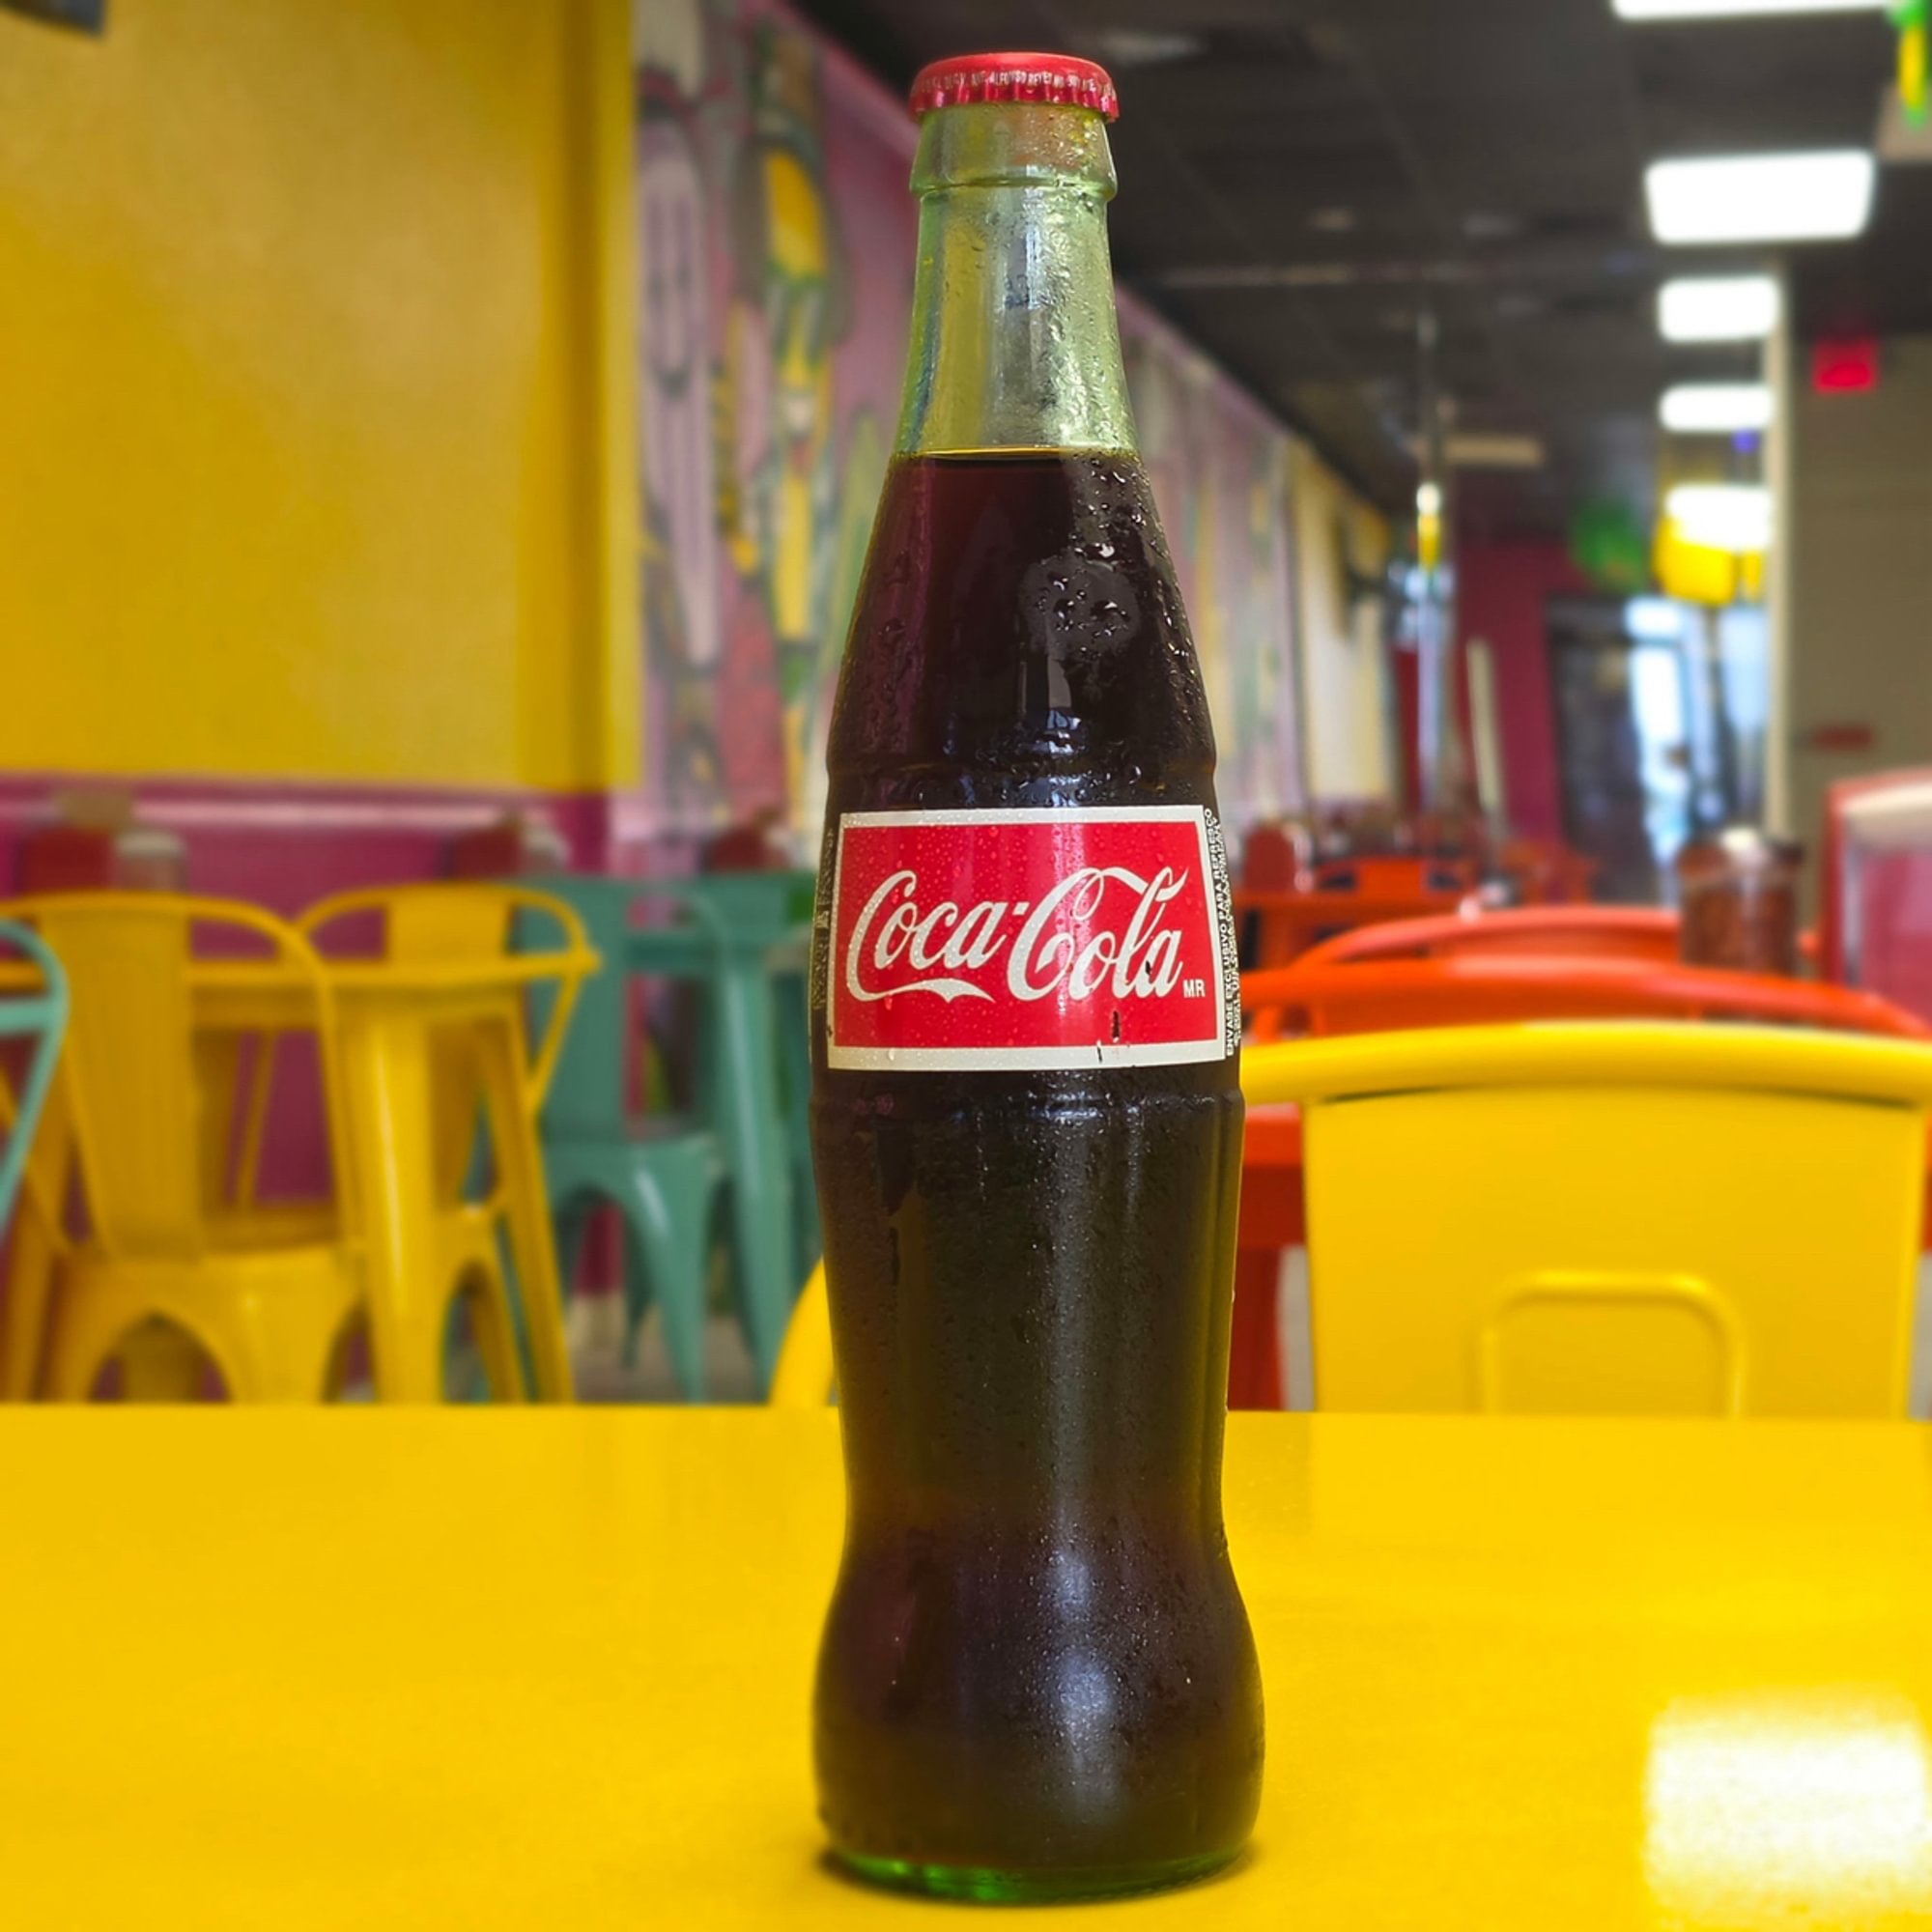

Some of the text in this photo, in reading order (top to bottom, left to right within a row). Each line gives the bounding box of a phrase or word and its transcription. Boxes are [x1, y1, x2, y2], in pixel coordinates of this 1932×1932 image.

[1215, 883, 1228, 921] PARA
[846, 866, 1189, 1004] Coca-Cola
[1218, 923, 1234, 1000] EXCLUSIVO
[1183, 978, 1207, 999] MR
[1225, 1002, 1236, 1057] ENVASE
